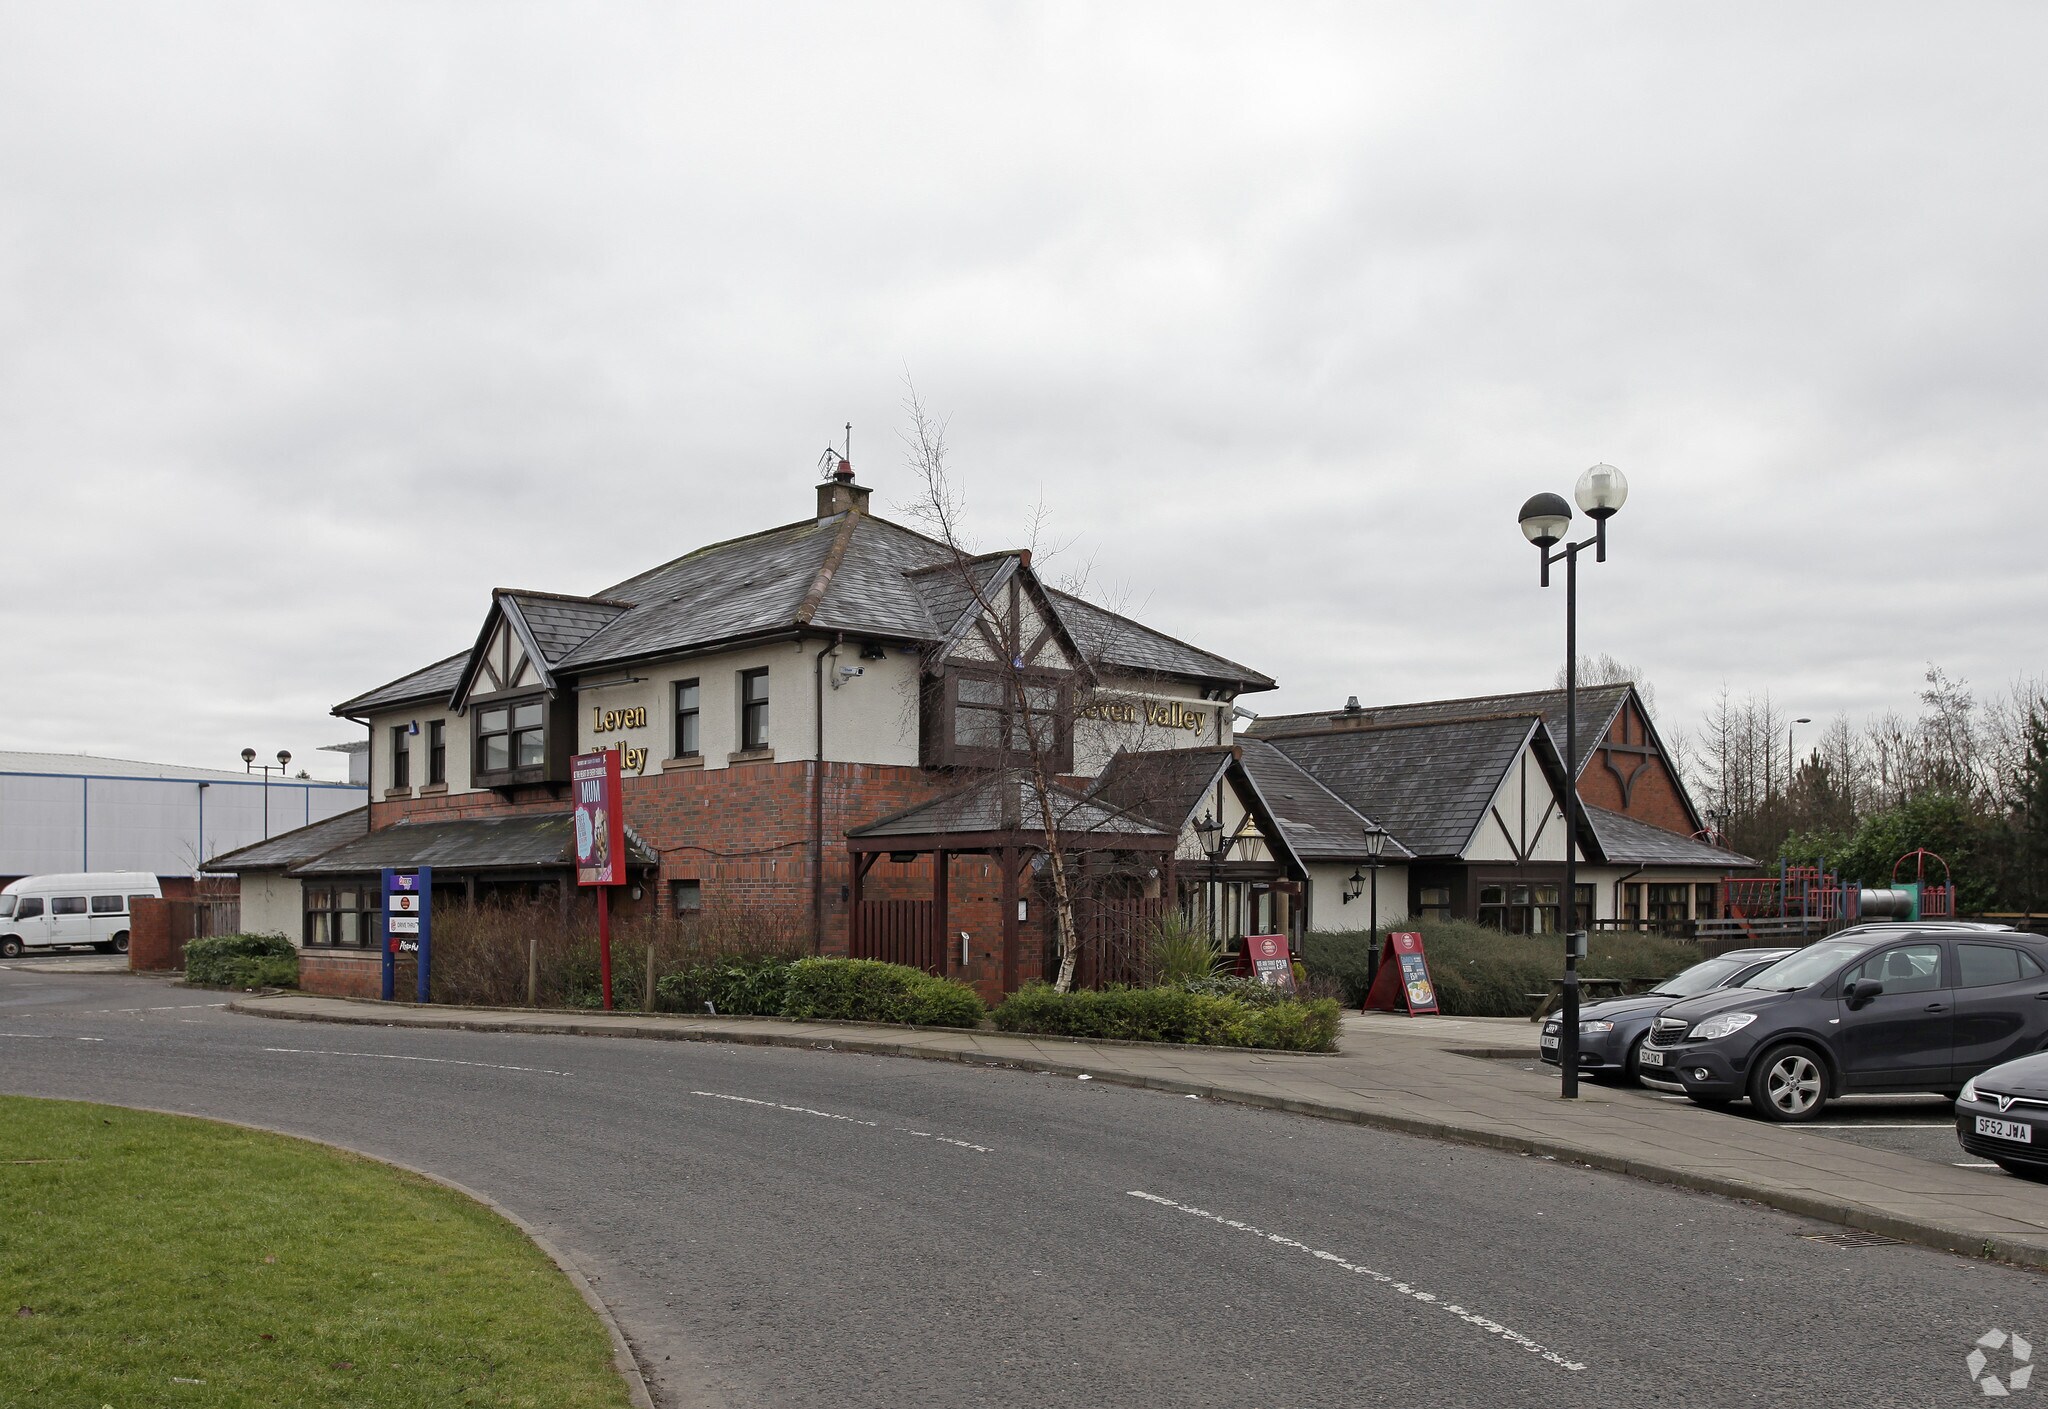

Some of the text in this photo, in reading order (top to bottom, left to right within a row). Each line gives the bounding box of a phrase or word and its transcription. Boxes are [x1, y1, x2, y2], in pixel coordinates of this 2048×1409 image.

[593, 706, 647, 733] Leven
[1144, 701, 1206, 736] Valley
[592, 740, 648, 775] ley
[581, 780, 601, 803] MUM
[411, 942, 419, 951] Hu
[1980, 1119, 2026, 1140] SF52 JWA
